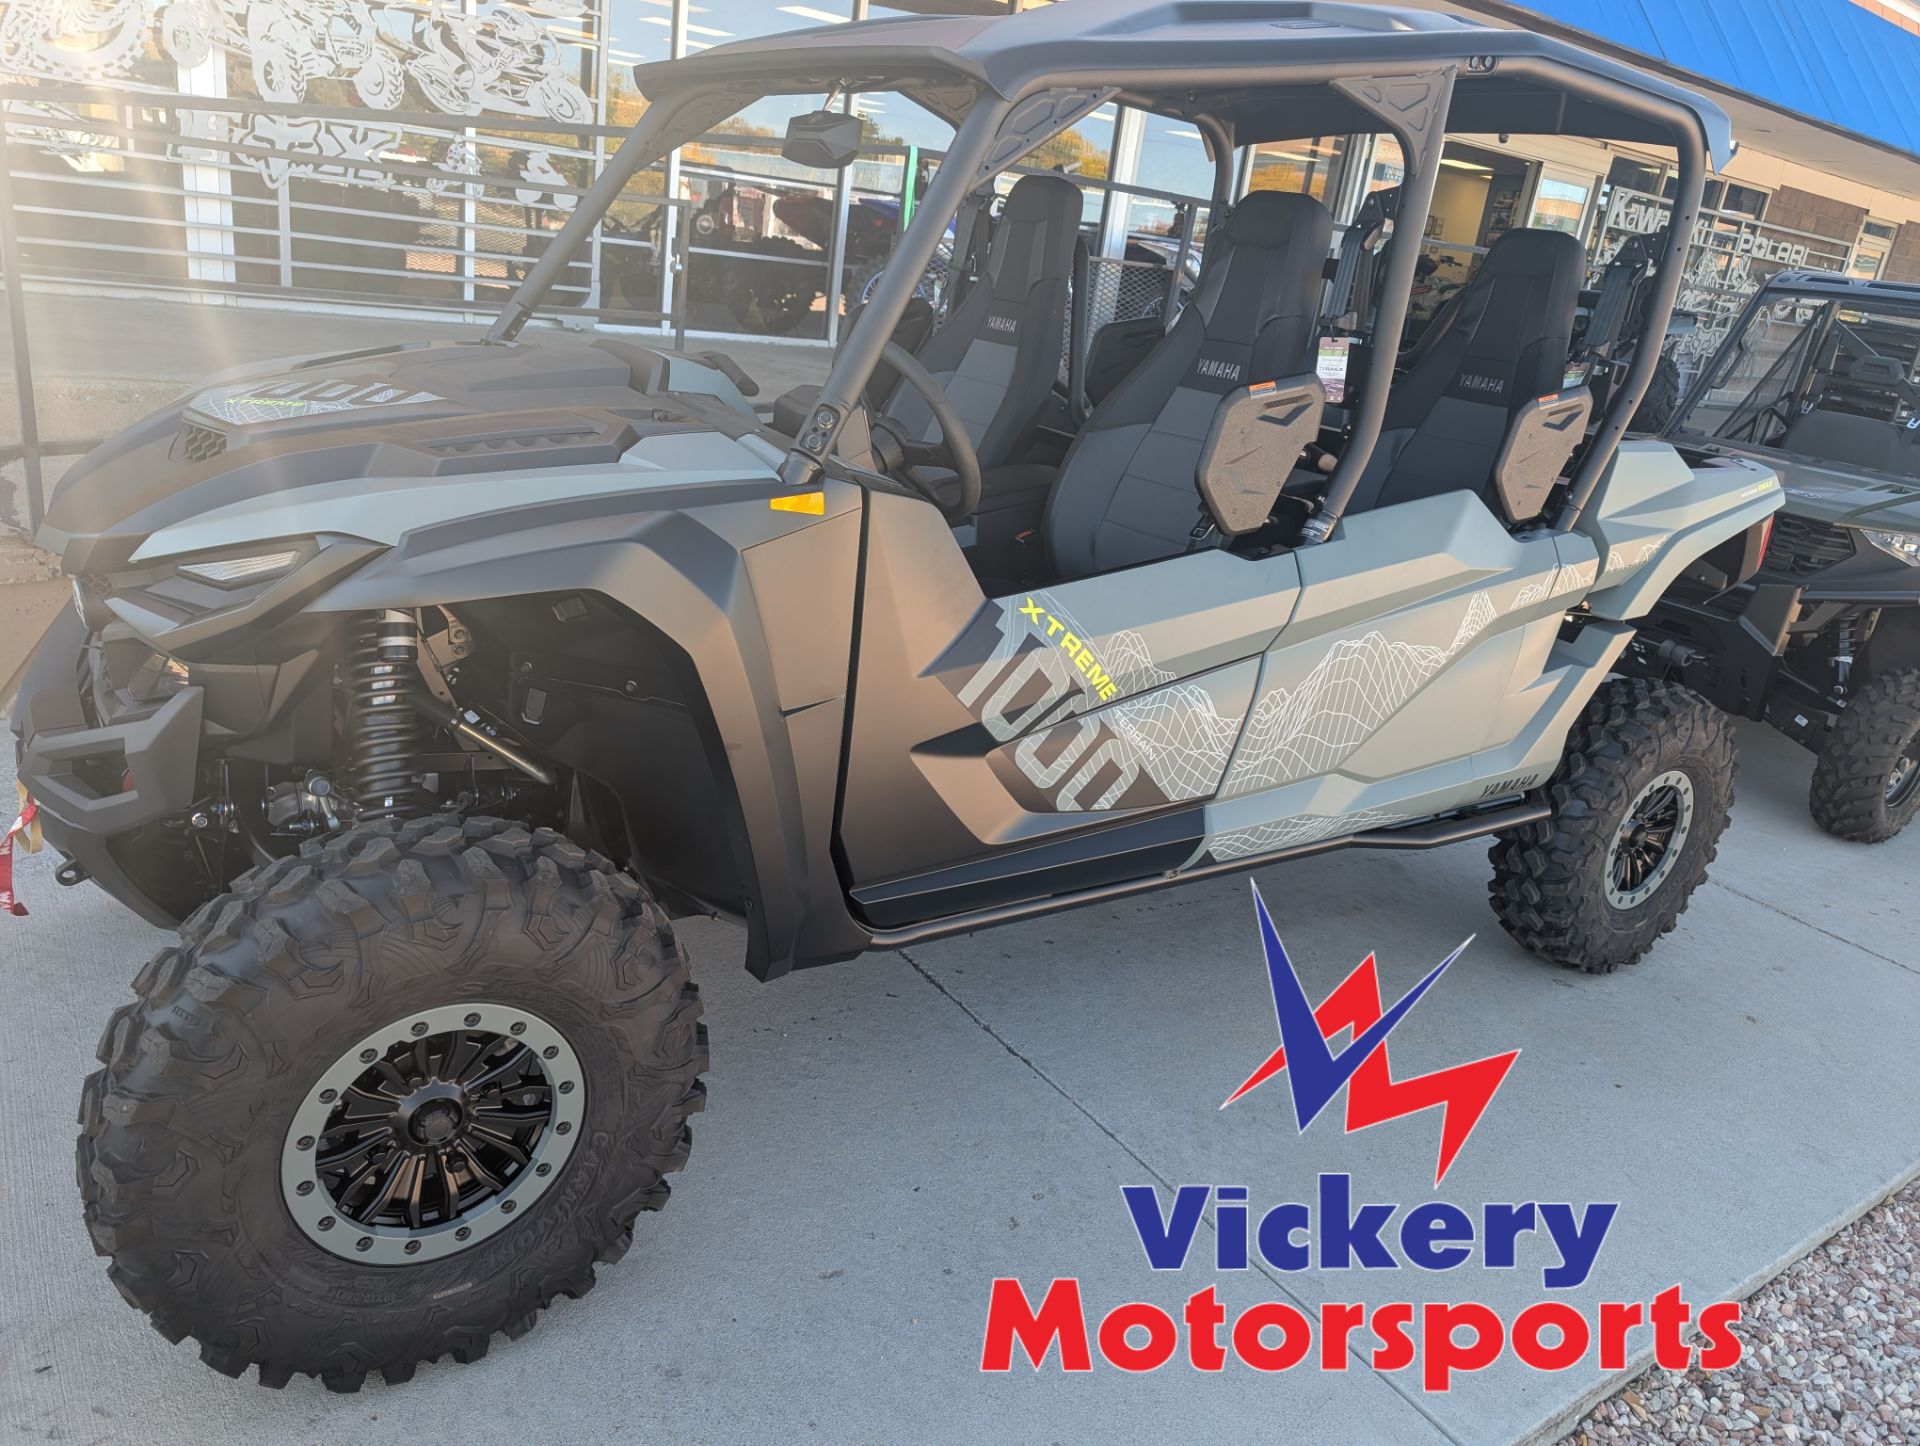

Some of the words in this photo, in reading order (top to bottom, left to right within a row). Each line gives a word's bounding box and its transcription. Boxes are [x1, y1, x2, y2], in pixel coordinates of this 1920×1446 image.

[987, 315, 1017, 333] YAMAHA
[1197, 358, 1241, 381] YAMAHA
[1459, 373, 1505, 393] YAMAHA
[1018, 596, 1118, 702] XTREME
[956, 595, 1141, 813] 1000
[1113, 708, 1158, 761] TERRAIN
[1479, 773, 1539, 799] YAMAHA
